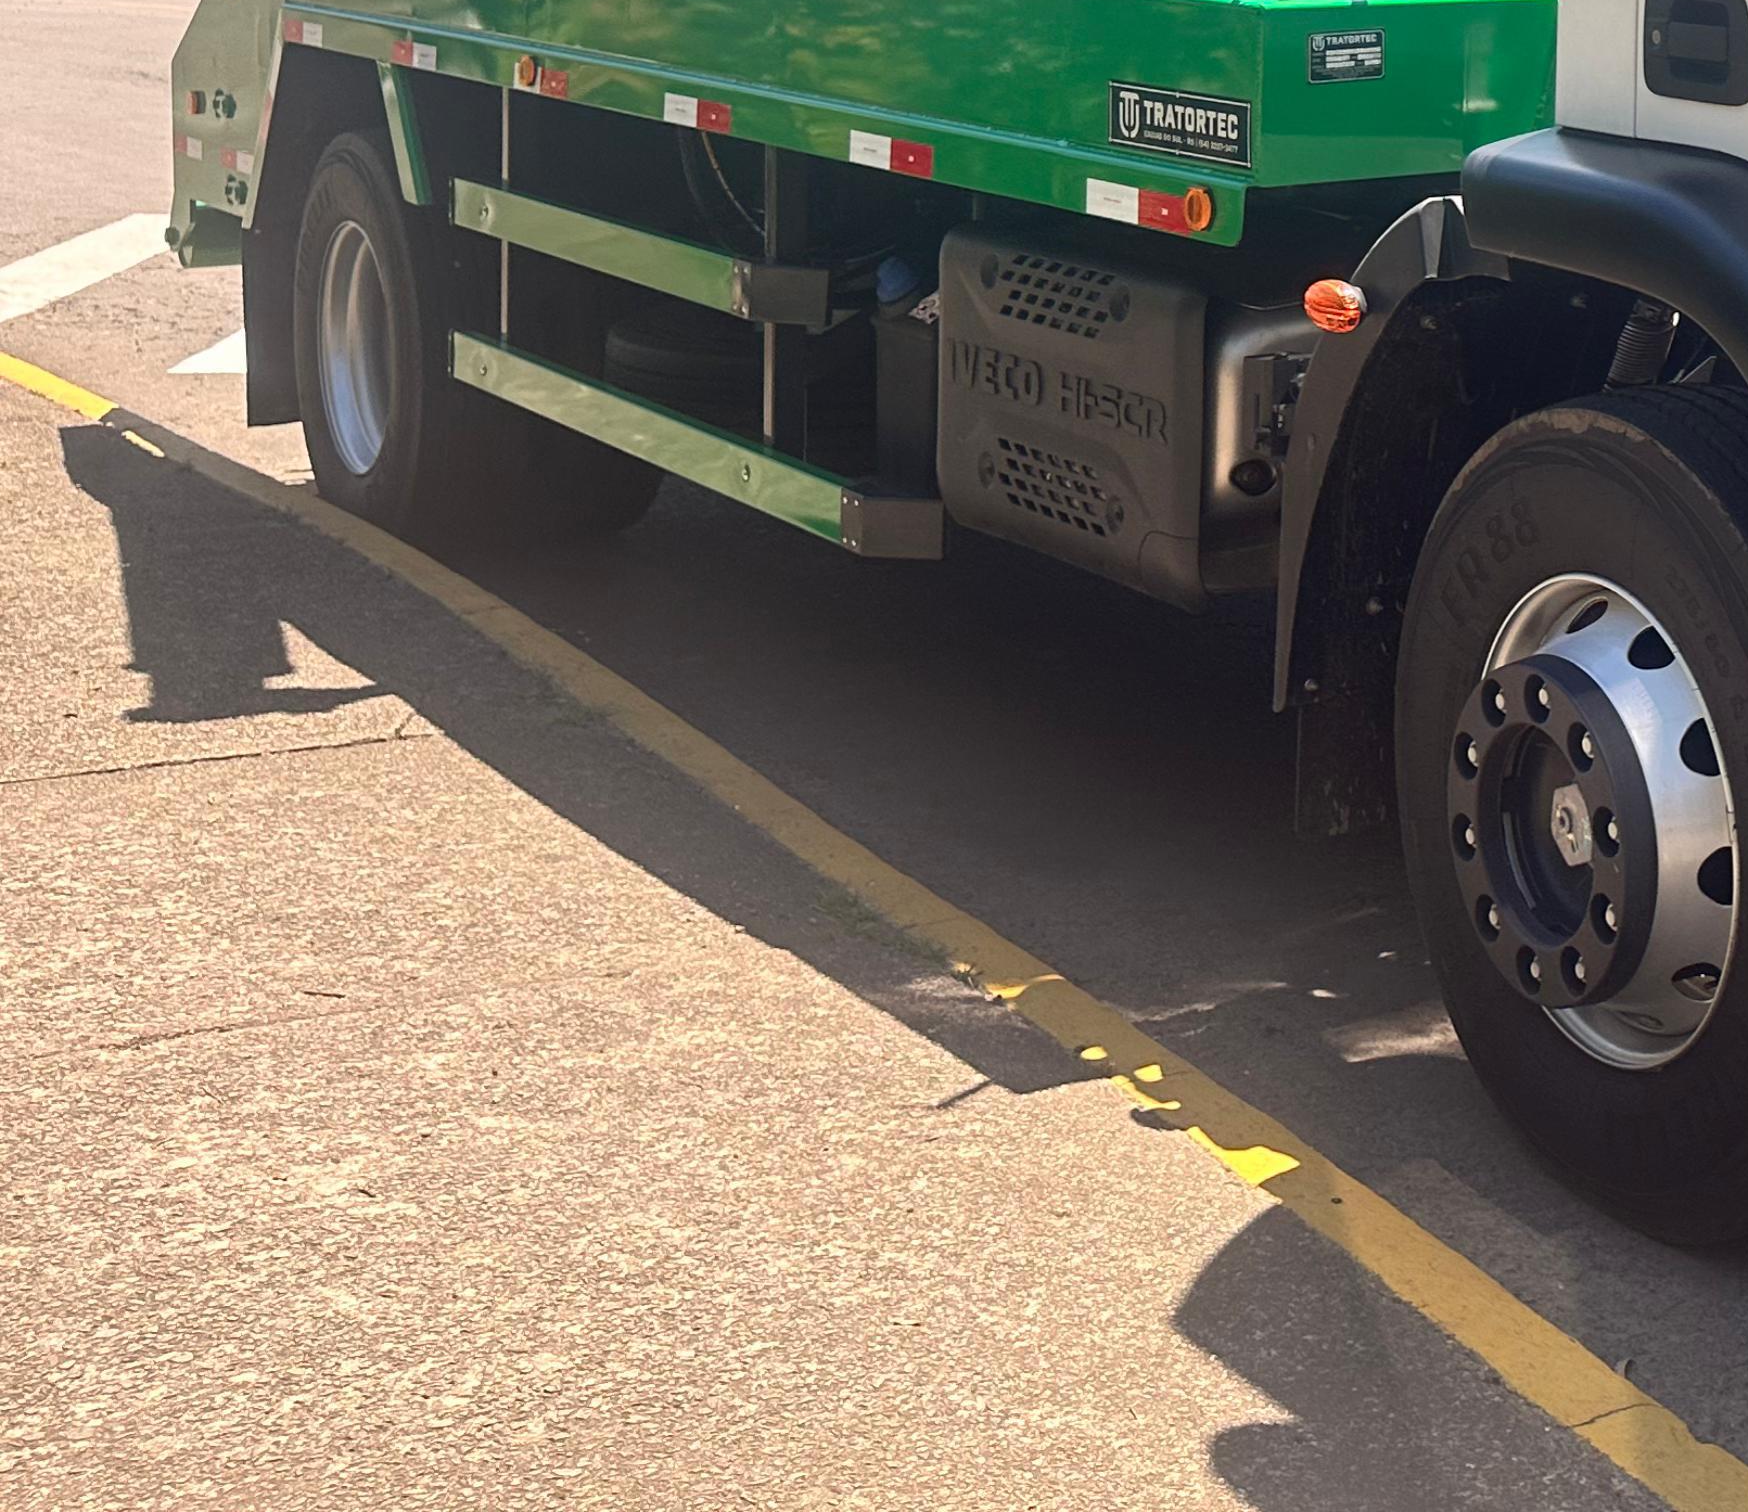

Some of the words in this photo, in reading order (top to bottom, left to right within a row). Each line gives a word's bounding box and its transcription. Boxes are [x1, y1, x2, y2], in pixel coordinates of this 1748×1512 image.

[1326, 33, 1378, 46] TRATORTEC
[1143, 99, 1239, 140] TRATORTEC
[948, 337, 1045, 407] IVECO
